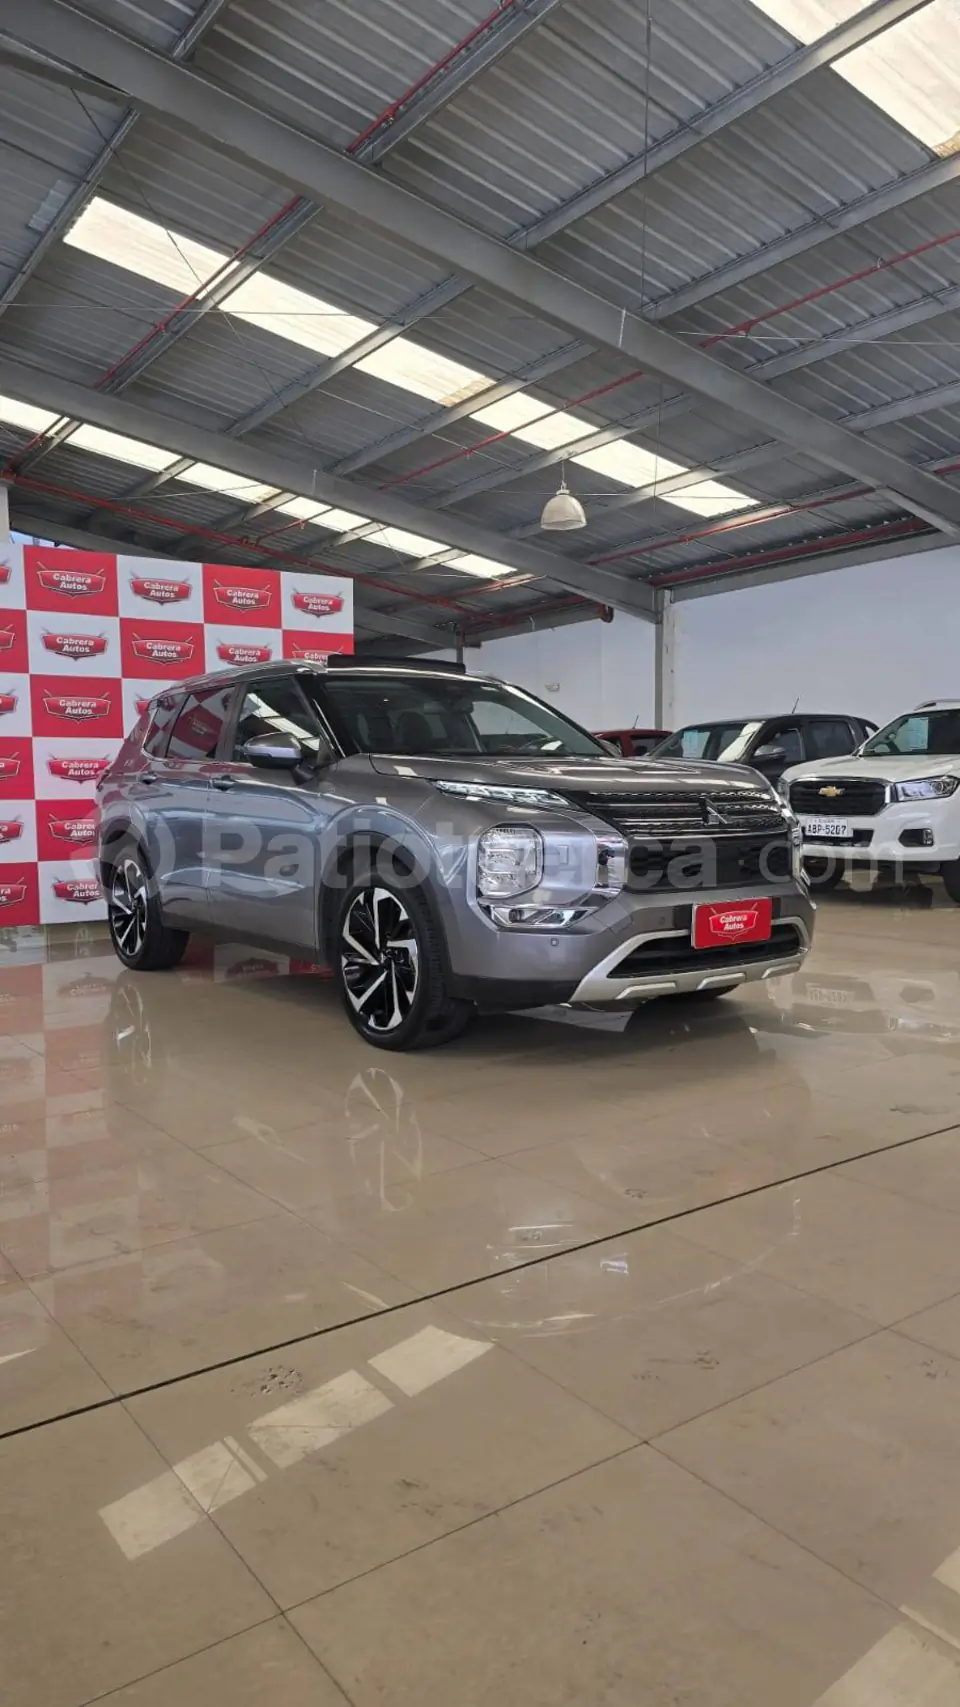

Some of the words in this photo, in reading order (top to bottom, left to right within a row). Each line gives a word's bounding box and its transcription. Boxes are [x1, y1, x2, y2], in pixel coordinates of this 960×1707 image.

[52, 572, 92, 584] Cabrera
[59, 582, 88, 590] Autos
[143, 581, 179, 592] Cabrera
[149, 589, 175, 598] Autos
[226, 589, 259, 599] Cabrera
[232, 596, 256, 605] Autos
[303, 596, 333, 605] Cabrera
[307, 603, 329, 611] Autos
[56, 636, 94, 646] Cabrera
[62, 644, 90, 653] Autos
[146, 642, 181, 652] Cabrera
[228, 647, 261, 656] Cabrera
[151, 649, 177, 658] Autos
[233, 654, 257, 662] Autos
[59, 699, 97, 708] Cabrera
[65, 706, 93, 715] Autos
[61, 760, 99, 769] Cabrera
[67, 768, 95, 776] Autos
[66, 882, 98, 891] Cabrer
[719, 914, 748, 923] Cabrera
[723, 922, 745, 931] Autos
